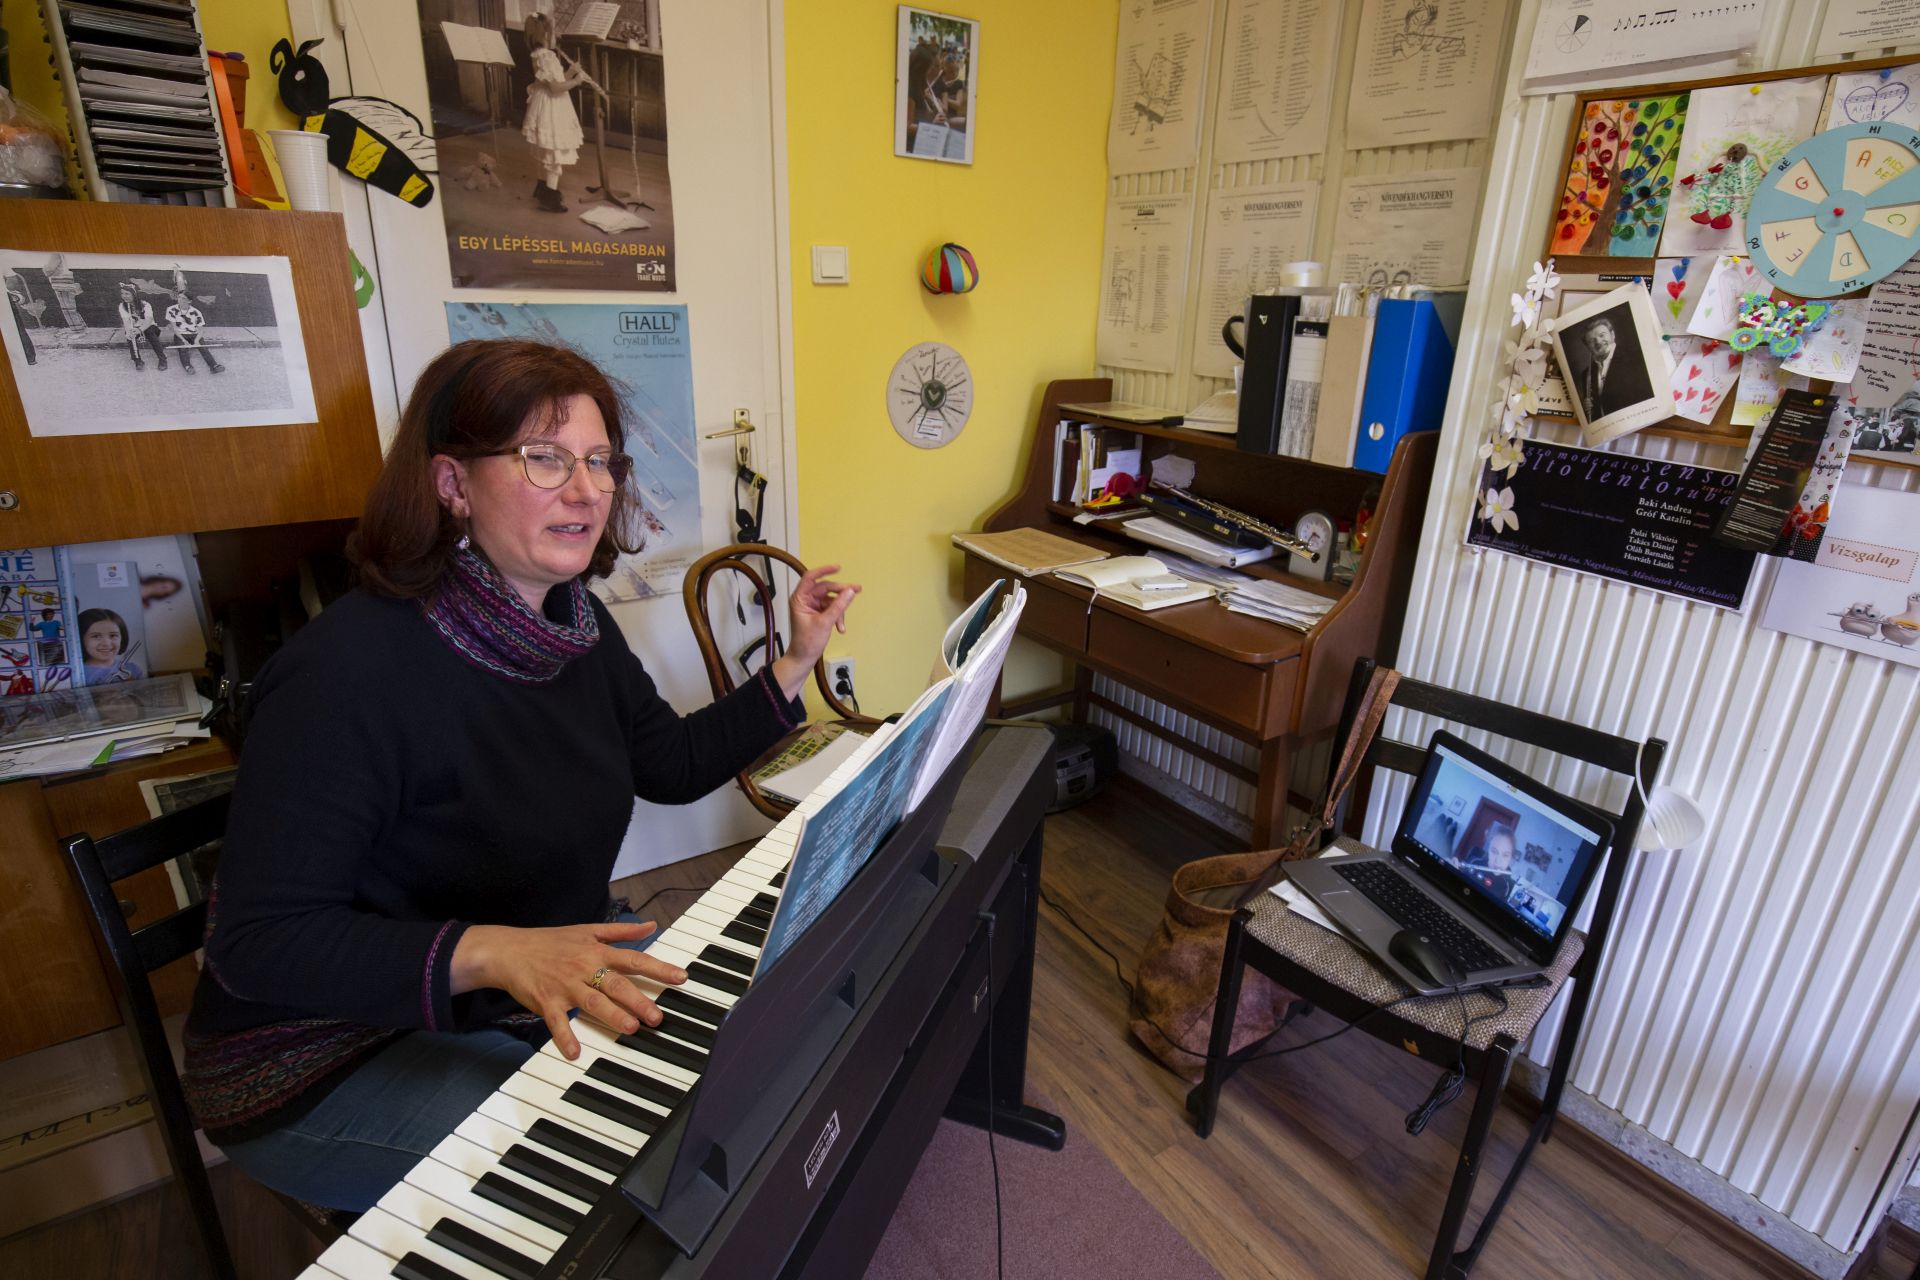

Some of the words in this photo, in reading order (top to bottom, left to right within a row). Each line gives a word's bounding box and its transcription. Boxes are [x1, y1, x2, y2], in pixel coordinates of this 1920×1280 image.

[1795, 176, 1809, 190] G
[458, 236, 489, 250] EGY
[493, 234, 568, 253] LÉPÉSSEL
[571, 240, 666, 257] MAGASABBAN
[625, 316, 671, 330] HALL
[613, 335, 648, 348] Crystal
[652, 335, 681, 346] Flutes
[1638, 497, 1658, 508] Baki
[1660, 502, 1692, 514] Andrea
[1636, 507, 1658, 519] Gróf
[1660, 512, 1692, 526] Katalin
[1628, 536, 1650, 546] Takács
[1652, 541, 1675, 552] Dániel
[1651, 532, 1678, 544] Viktória
[1624, 553, 1651, 564] Horváth
[1653, 560, 1675, 570] László
[1645, 549, 1674, 561] Barnabás
[1829, 543, 1900, 569] Vizsgalap
